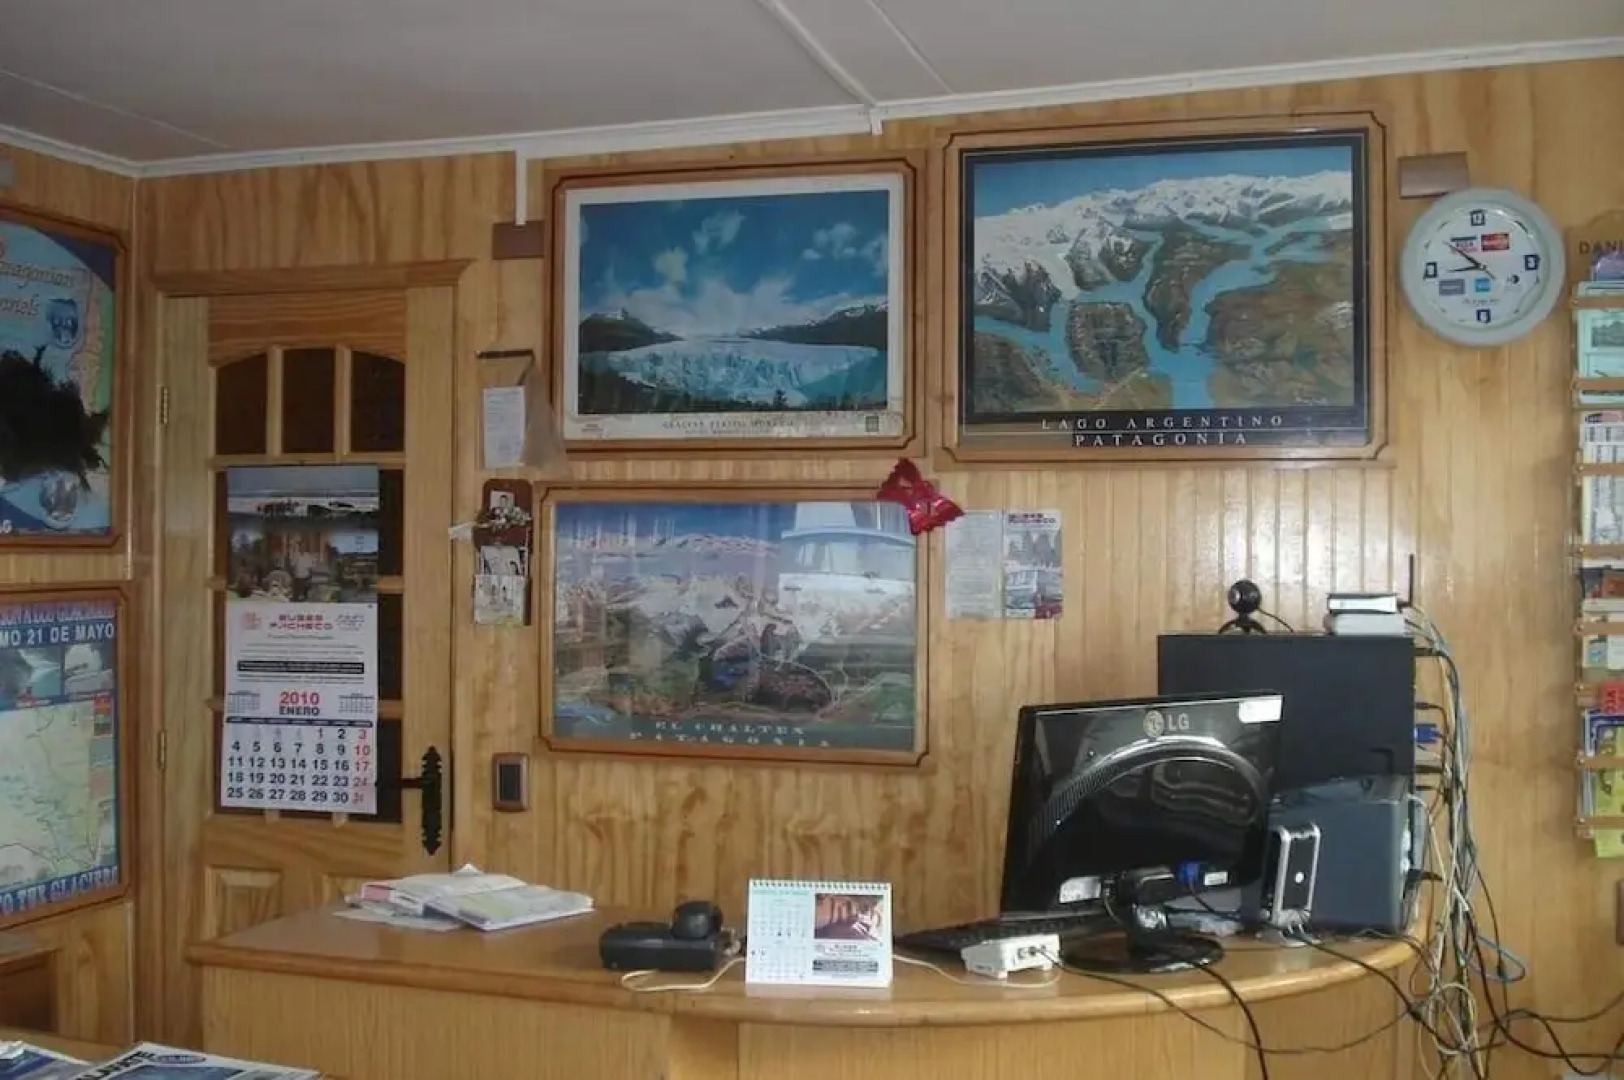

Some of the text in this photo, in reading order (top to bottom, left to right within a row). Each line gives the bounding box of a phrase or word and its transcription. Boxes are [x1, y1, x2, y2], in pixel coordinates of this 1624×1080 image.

[1042, 415, 1283, 430] LAGO ARGENTINO
[1075, 432, 1247, 446] PATAGONIA
[27, 628, 43, 645] 21
[50, 626, 69, 643] DE
[75, 623, 115, 641] MAYO
[280, 691, 320, 705] 2010
[279, 706, 320, 716] ENERO
[1168, 713, 1190, 731] LG
[355, 745, 370, 756] 10
[229, 757, 370, 772] 11 12 13 14 15 16 17
[228, 772, 367, 787] 18 19 20 21 22 23 24
[226, 788, 244, 798] 25
[248, 788, 264, 799] 26
[269, 789, 285, 800] 27
[290, 790, 306, 801] 28
[312, 790, 327, 801] 29
[333, 792, 349, 803] 30
